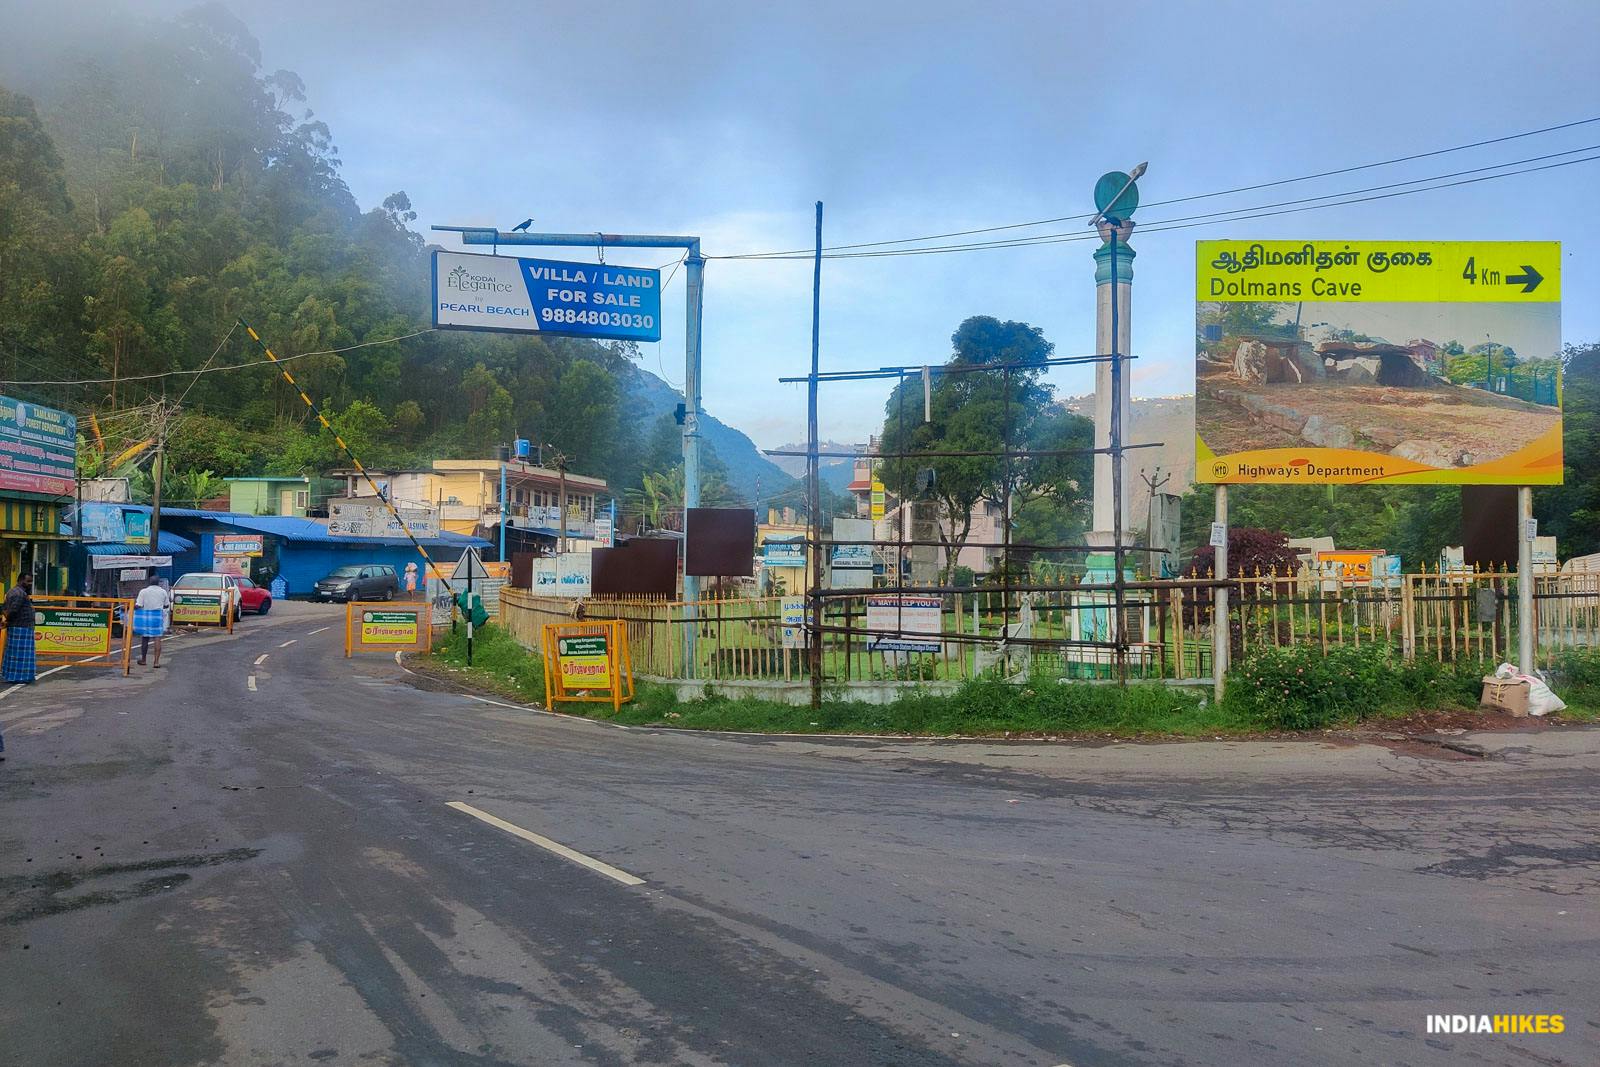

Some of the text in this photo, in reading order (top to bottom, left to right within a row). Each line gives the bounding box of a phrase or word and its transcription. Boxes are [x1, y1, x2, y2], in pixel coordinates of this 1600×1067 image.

[1211, 243, 1433, 273] ஆதிமனிதன் குகை
[470, 275, 496, 283] KODAI
[529, 266, 587, 283] VILLA
[603, 273, 653, 288] LAND
[1462, 256, 1501, 286] 4 Km
[448, 274, 513, 293] Elegance
[1210, 278, 1362, 297] Dolmans Cave
[548, 289, 641, 307] FOR SALE
[440, 303, 529, 316] PEARL BEACH
[542, 308, 653, 329] 9884803030
[1239, 464, 1384, 480] Highways Department
[44, 631, 102, 643] Rajmahal
